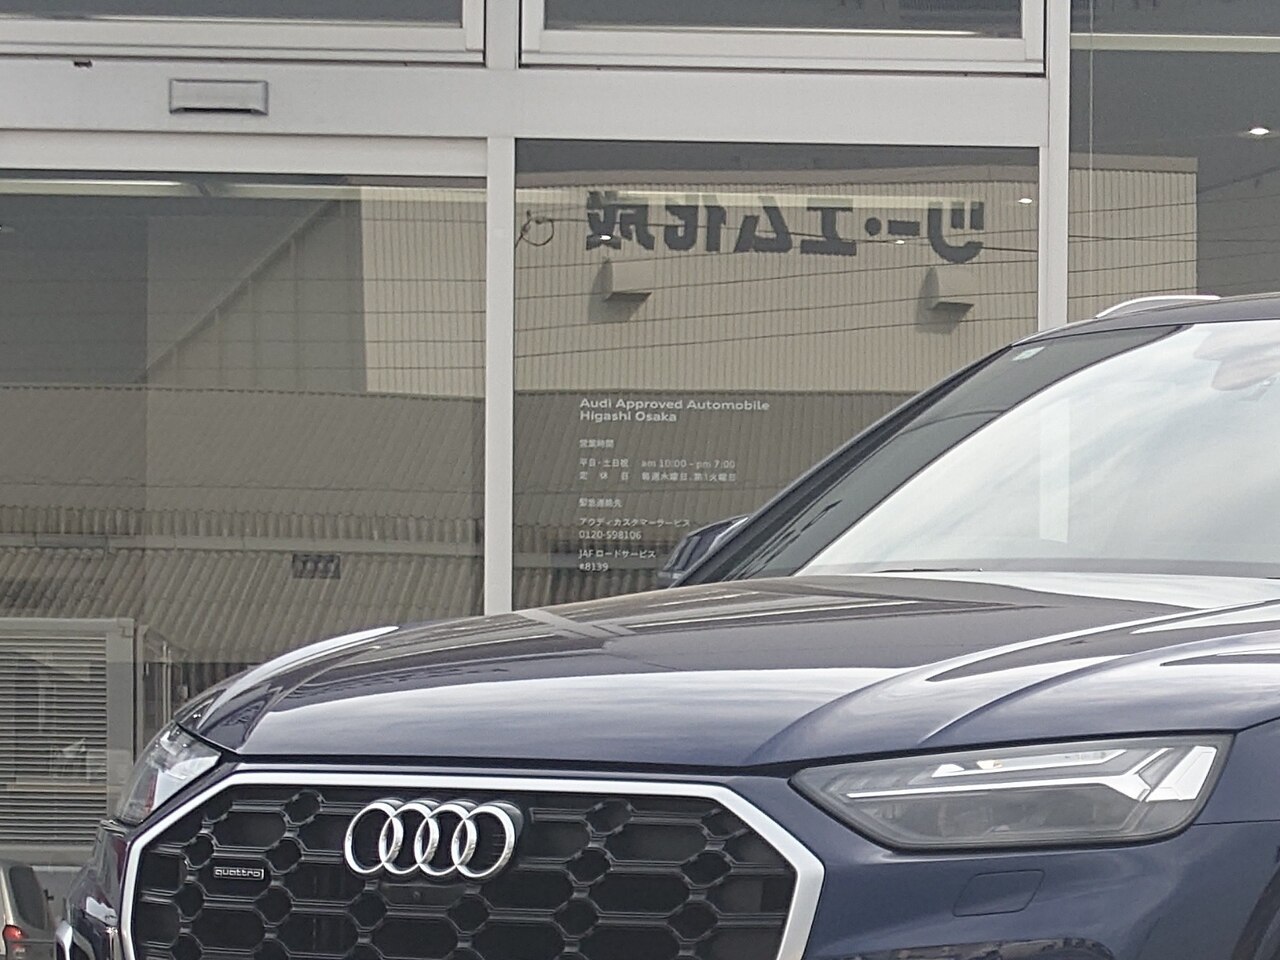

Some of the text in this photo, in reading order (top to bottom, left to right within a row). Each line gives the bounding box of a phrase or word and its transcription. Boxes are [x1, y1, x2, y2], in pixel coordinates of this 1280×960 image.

[580, 398, 770, 412] Audi Approved Automobile
[580, 410, 677, 423] Higashi Osaka
[578, 530, 642, 540] 0120-598106
[578, 549, 657, 559] JAF ロードサービス
[214, 868, 261, 878] quattro
